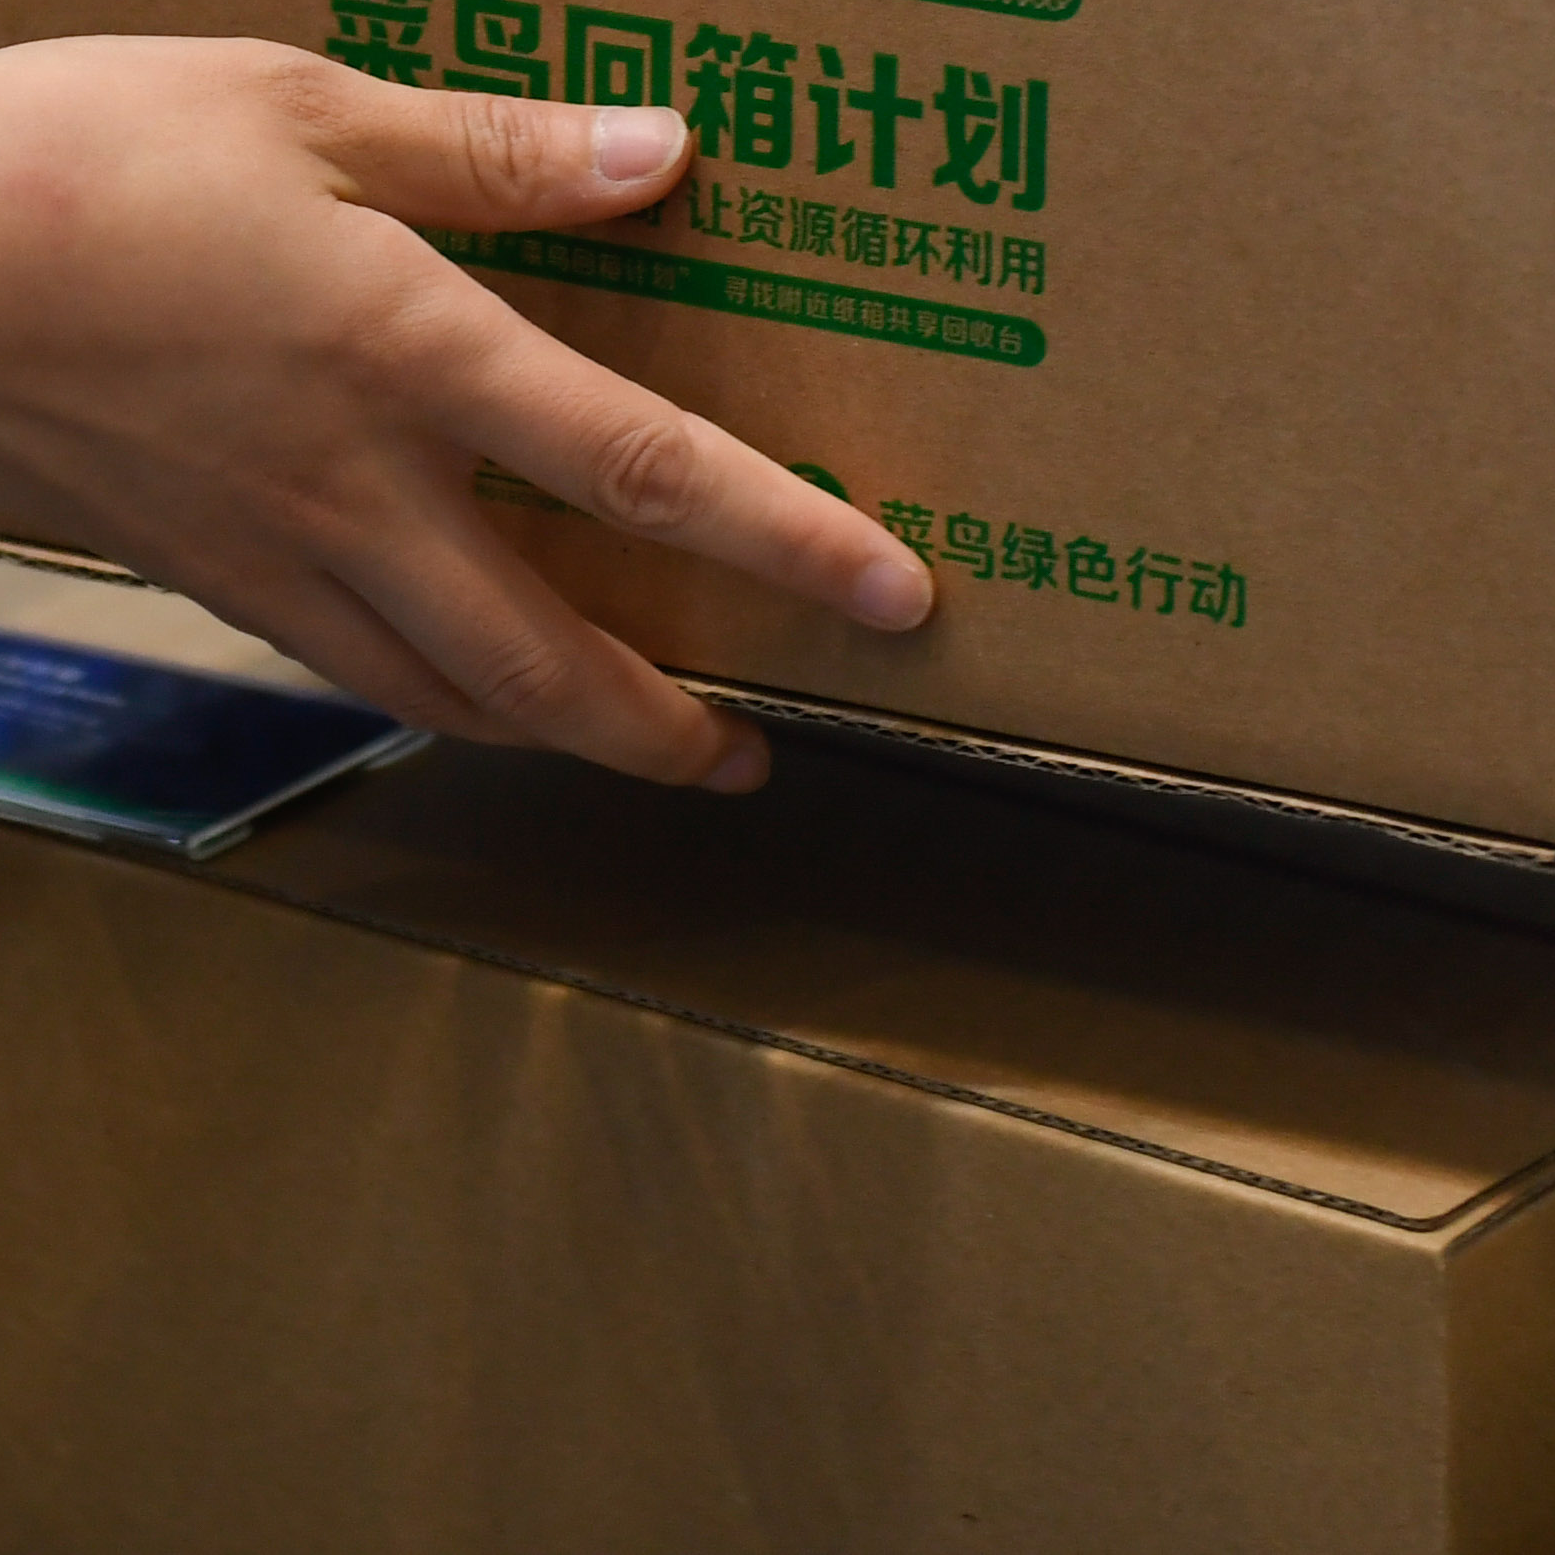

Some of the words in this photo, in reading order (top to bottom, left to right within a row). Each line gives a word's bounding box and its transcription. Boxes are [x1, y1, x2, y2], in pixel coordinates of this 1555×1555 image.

[687, 176, 1047, 295] 让资源循环利用
[723, 274, 1024, 356] 寻找附近纸箱共享回收台
[878, 498, 1247, 628] 菜鸟绿色行动
